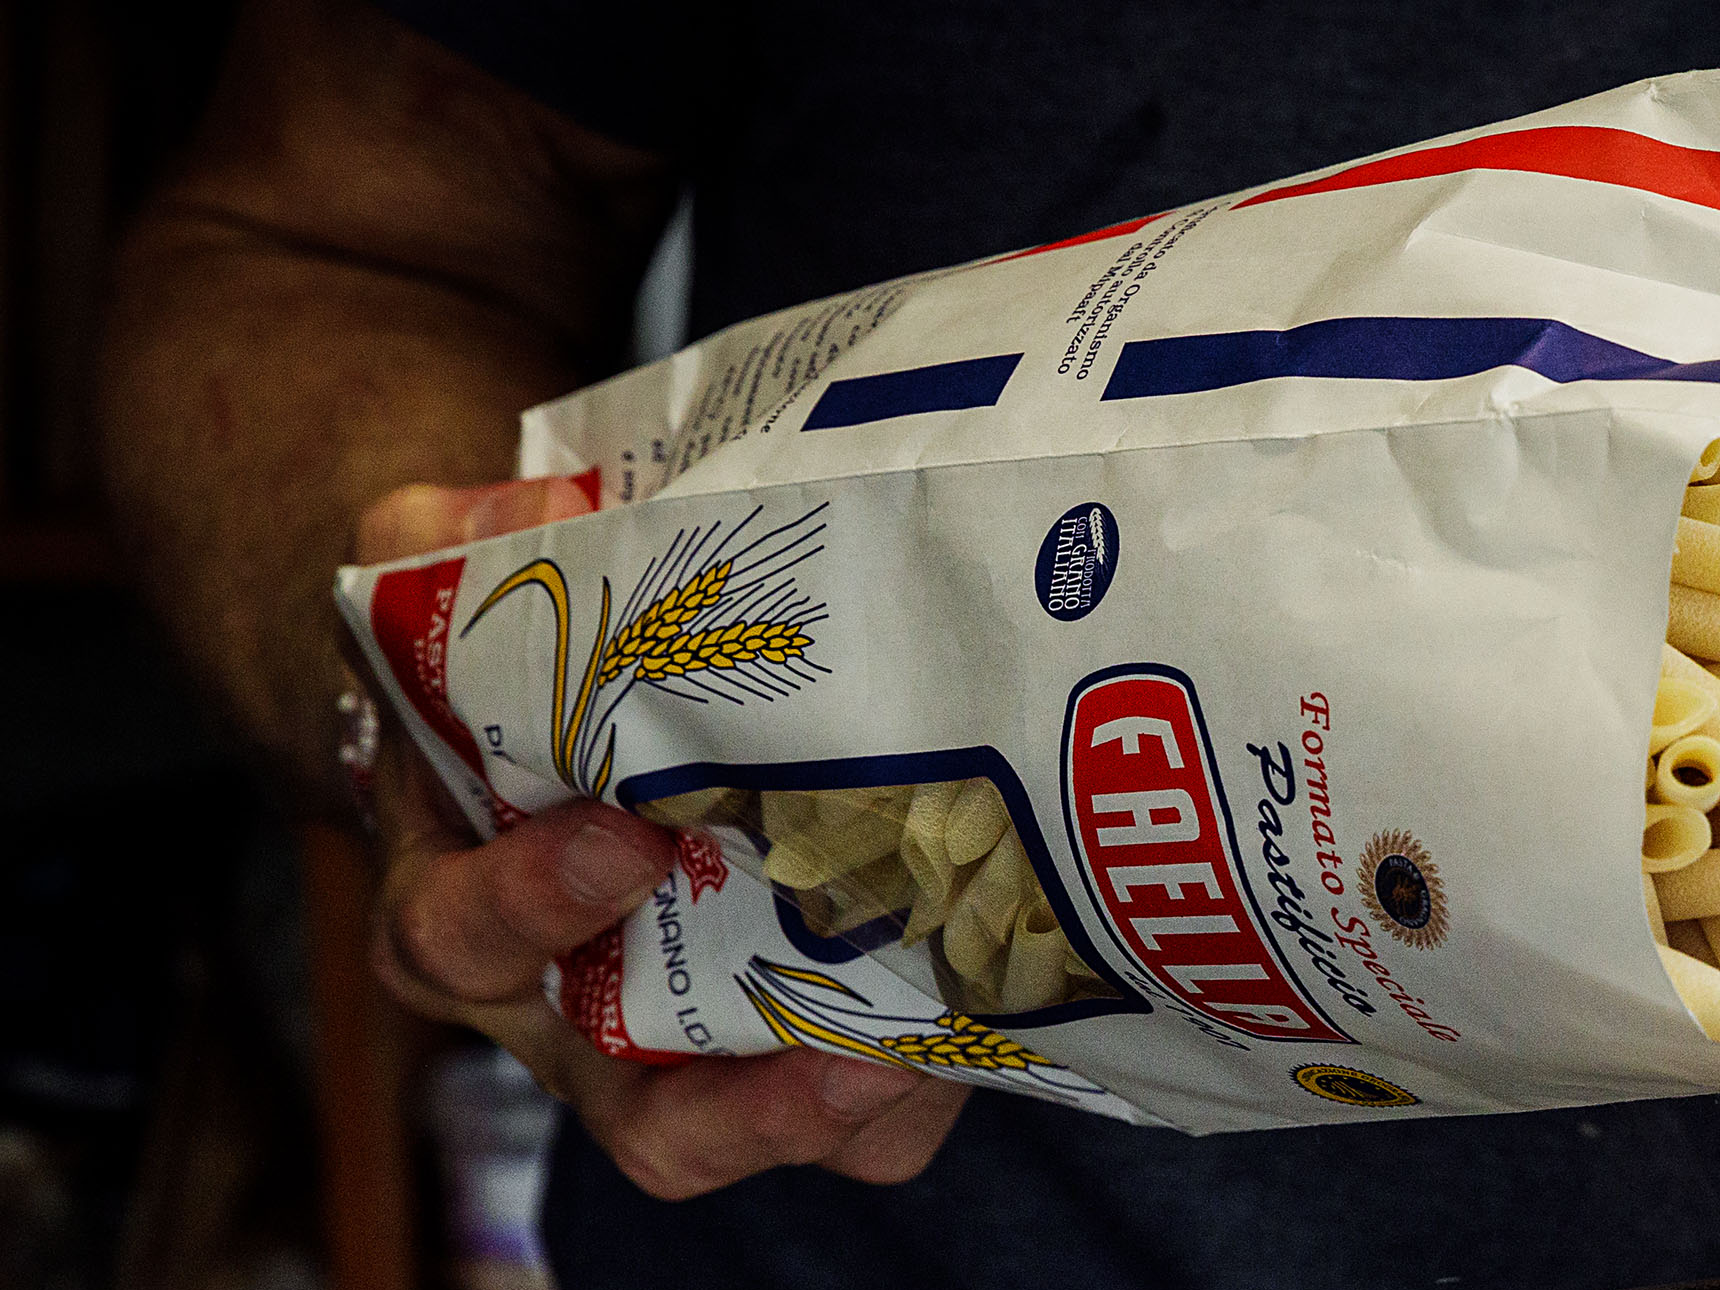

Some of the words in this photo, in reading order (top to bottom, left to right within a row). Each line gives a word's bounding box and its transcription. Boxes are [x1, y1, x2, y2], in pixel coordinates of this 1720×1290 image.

[1116, 242, 1143, 264] dal
[1133, 262, 1157, 281] da
[1057, 279, 1123, 375] autorizzato
[1066, 265, 1123, 324] Mipaaft
[1076, 284, 1141, 380] Organismo
[1048, 517, 1078, 612] ITALIANO
[1075, 516, 1088, 539] CON
[1064, 543, 1088, 610] GRANO
[1080, 548, 1097, 609] PRODOTTA
[1090, 716, 1312, 1040] FAELLA
[1246, 741, 1378, 1018] Pastificio
[1300, 692, 1345, 896] Formato
[1331, 907, 1460, 1043] Speciale
